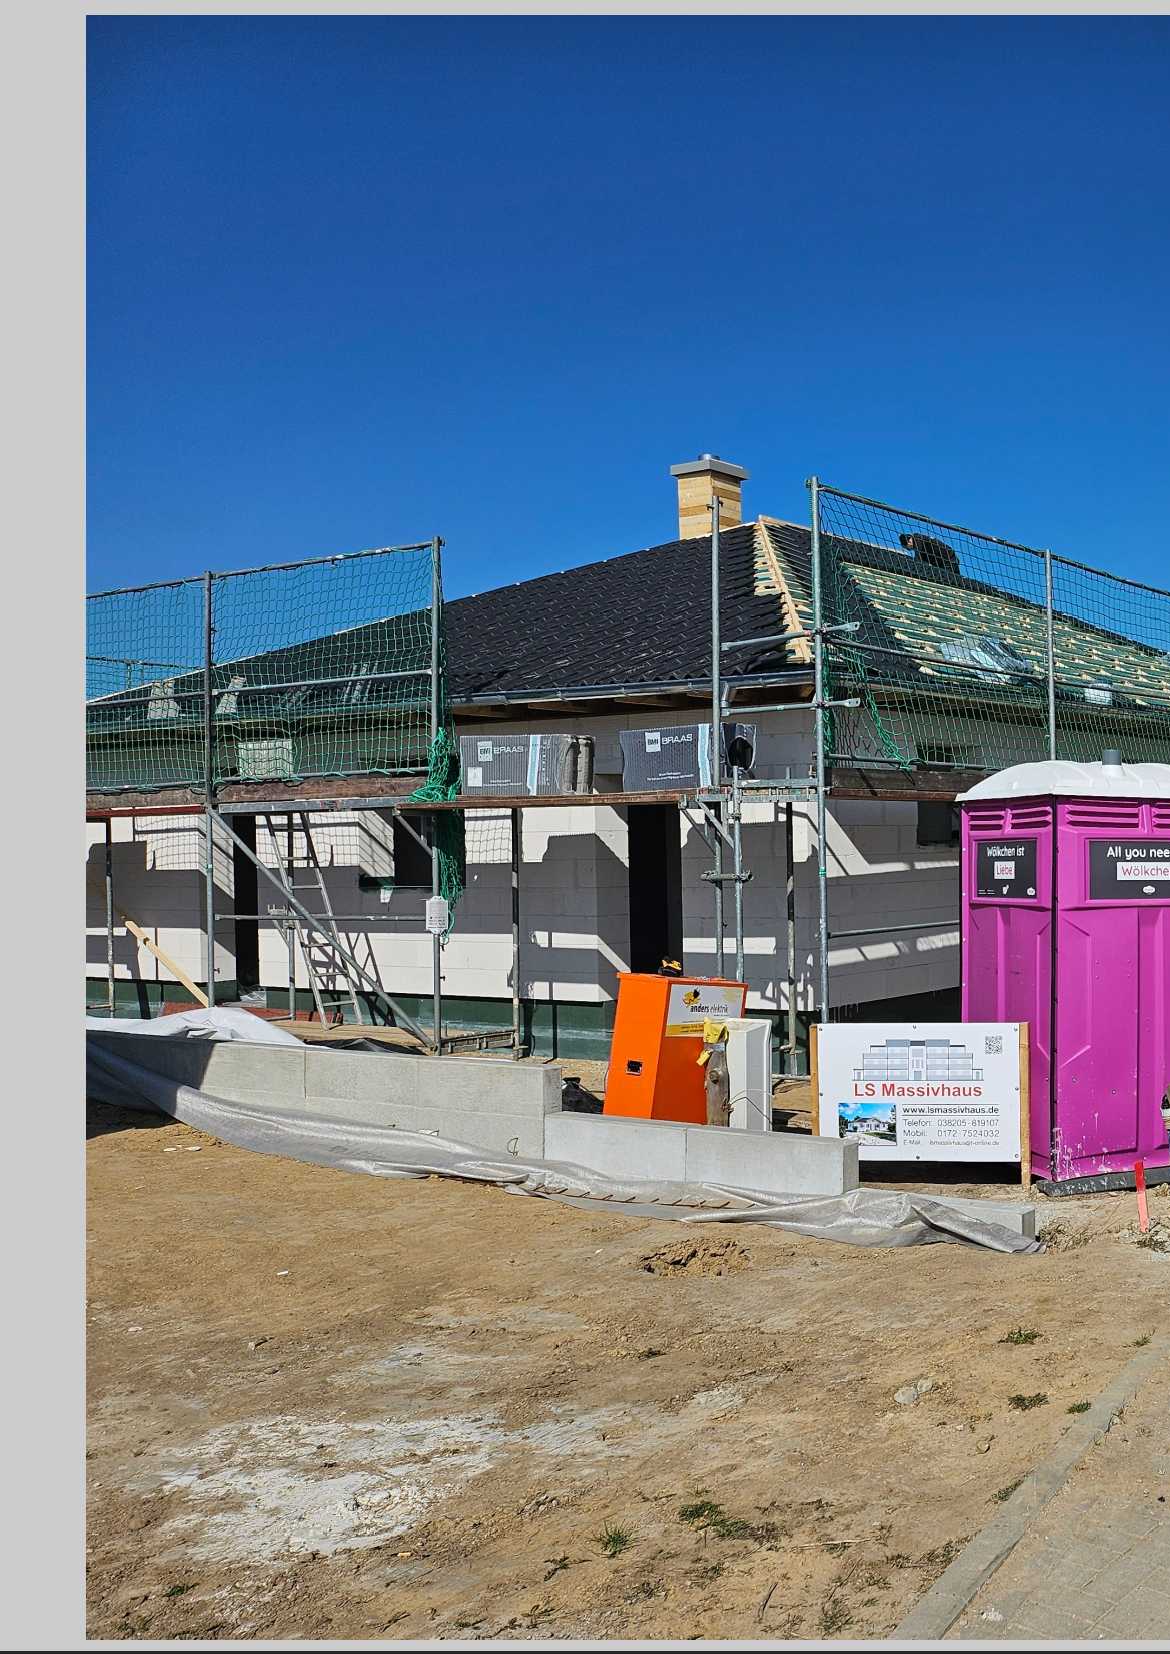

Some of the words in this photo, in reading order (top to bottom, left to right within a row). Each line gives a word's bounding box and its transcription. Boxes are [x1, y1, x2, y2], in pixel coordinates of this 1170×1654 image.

[661, 733, 693, 745] BRAAS
[986, 845, 1015, 857] Wölkchen
[1016, 845, 1025, 857] ist
[1106, 846, 1122, 858] All
[1125, 848, 1146, 860] you
[996, 863, 1013, 876] Liebe
[690, 1003, 709, 1013] anders
[854, 1083, 876, 1097] LS
[881, 1083, 983, 1097] Massivhaus
[902, 1105, 999, 1114] www.lsmassivhaus.de
